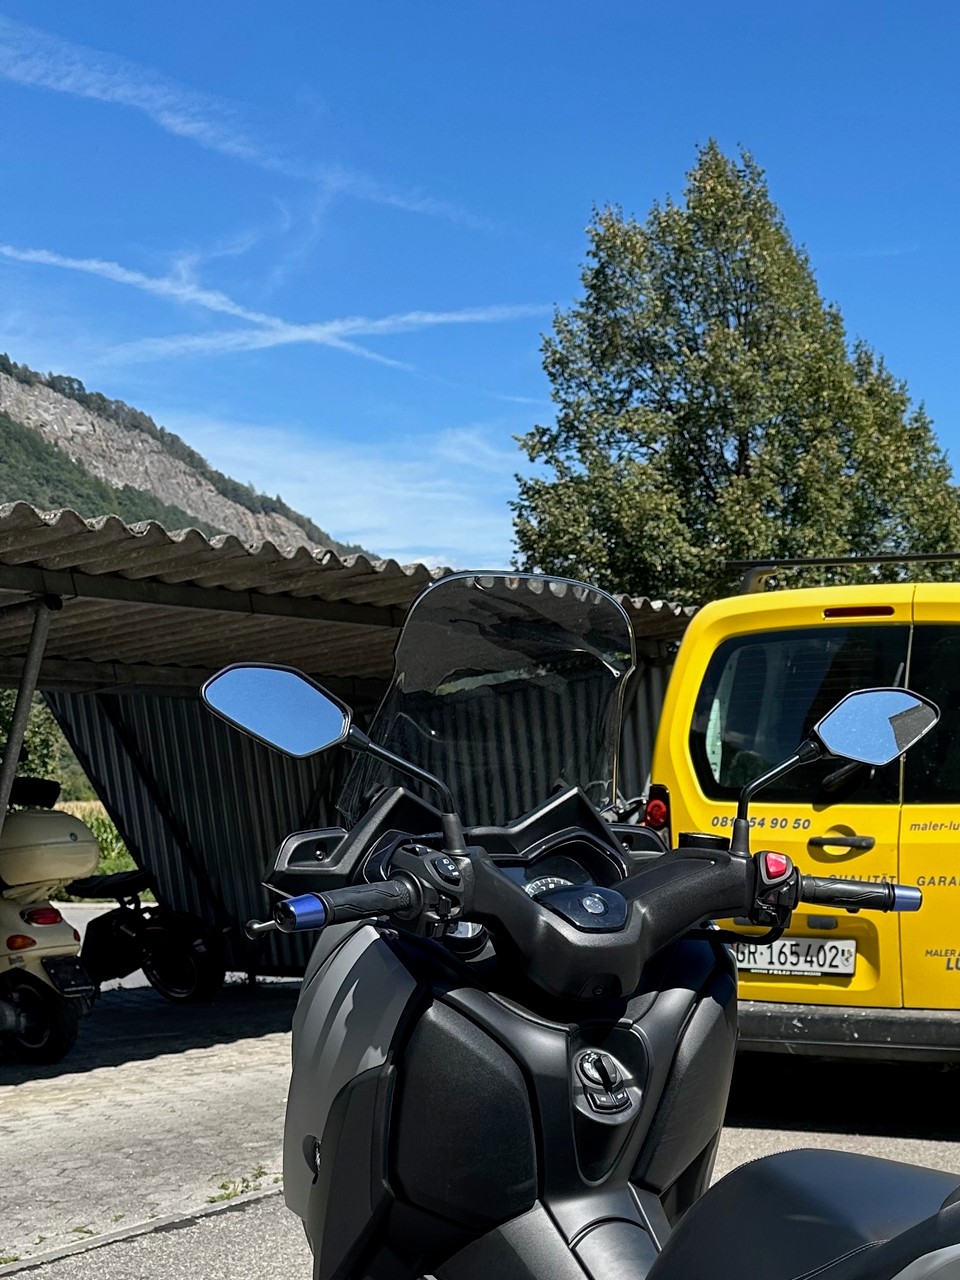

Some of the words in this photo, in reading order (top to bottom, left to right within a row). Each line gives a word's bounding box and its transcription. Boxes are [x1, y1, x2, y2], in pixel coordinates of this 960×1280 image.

[770, 818, 788, 829] 90
[792, 818, 811, 829] 50
[925, 949, 956, 957] MALER
